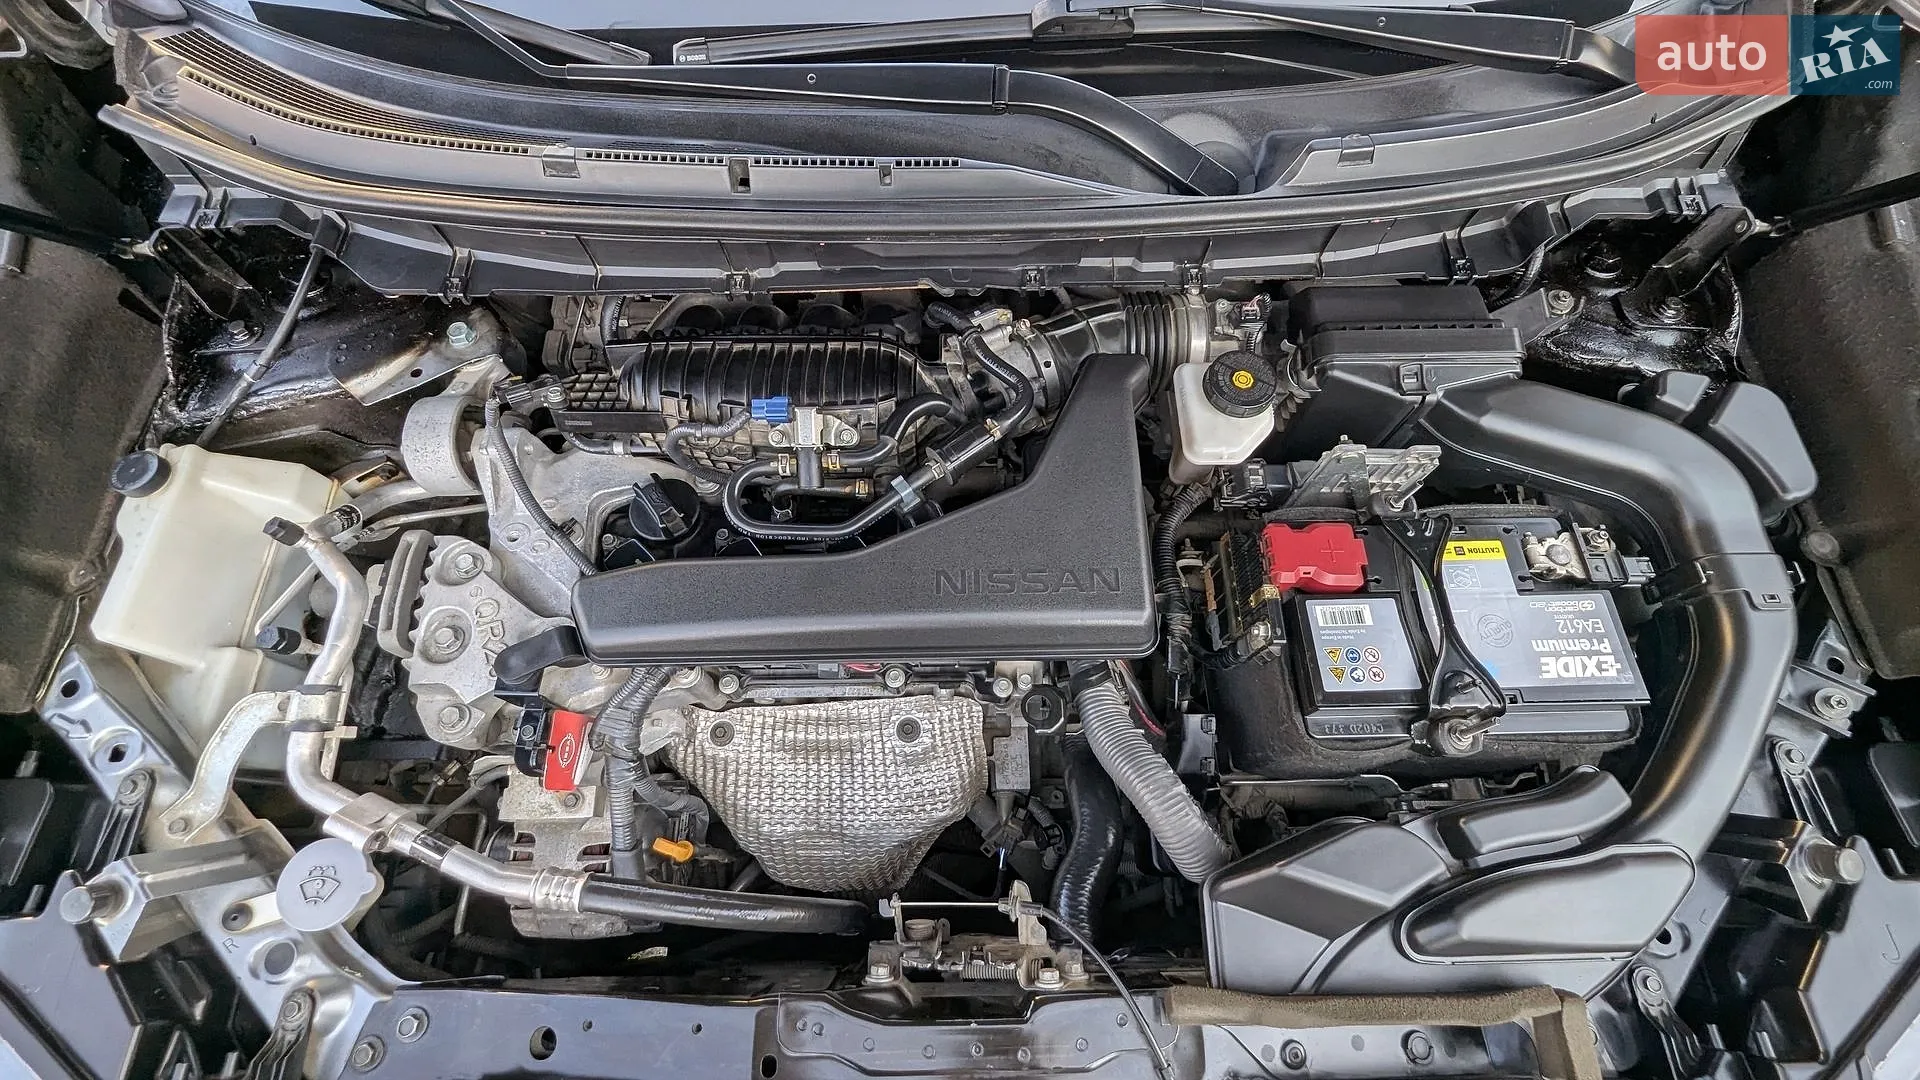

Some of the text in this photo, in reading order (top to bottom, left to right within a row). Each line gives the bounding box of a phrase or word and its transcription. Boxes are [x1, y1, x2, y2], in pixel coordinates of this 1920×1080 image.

[935, 568, 1121, 594] NISSAN
[1555, 618, 1605, 633] EA612
[1531, 637, 1613, 654] Premium
[1539, 655, 1621, 678] EXIDE
[1324, 724, 1345, 733] 373
[222, 937, 241, 954] R
